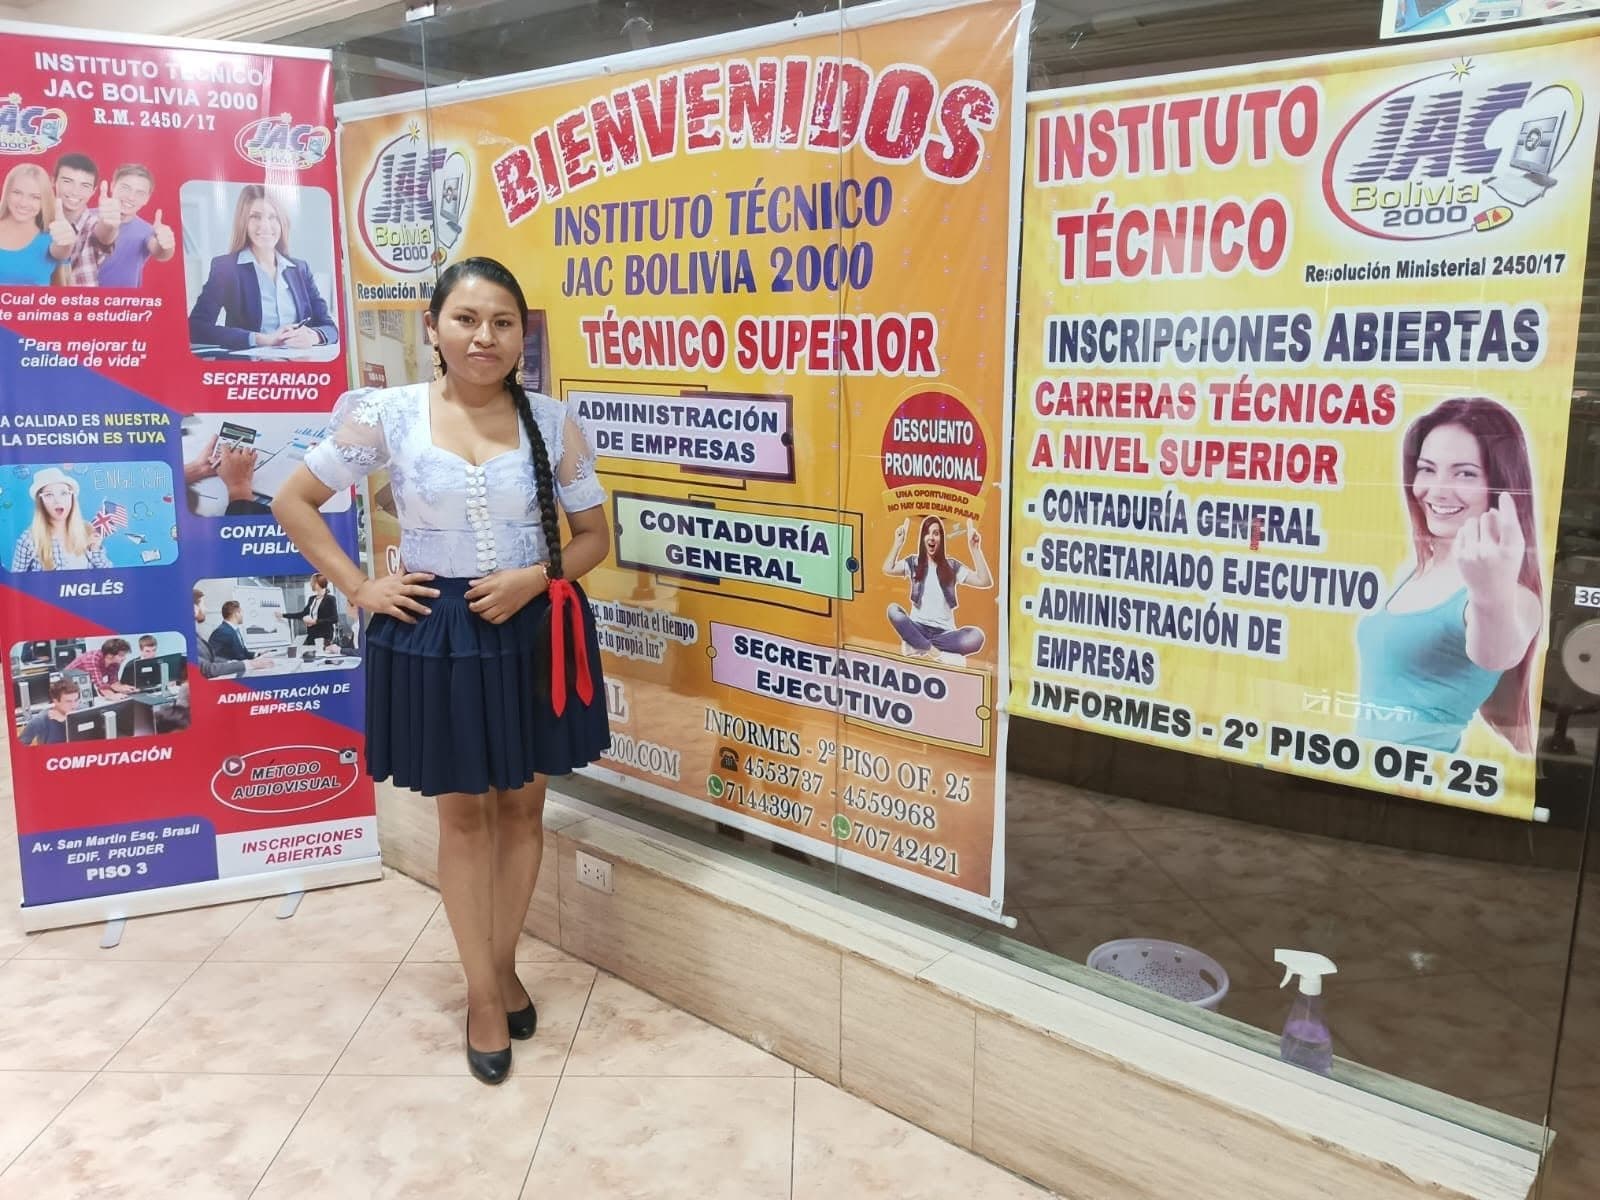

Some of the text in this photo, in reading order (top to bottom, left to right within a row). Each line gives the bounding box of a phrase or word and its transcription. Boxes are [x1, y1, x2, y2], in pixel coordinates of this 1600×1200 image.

[35, 51, 158, 79] INSTITUTO
[43, 78, 258, 110] JAC BOLIVIA 2000
[93, 107, 216, 131] R.M. 2450/17
[1038, 84, 1319, 183] INSTITUTO
[1345, 81, 1533, 183] JAC
[244, 121, 313, 152] JAC
[493, 58, 997, 223] BIENVENIDOS
[370, 147, 448, 224] JAC
[1350, 178, 1480, 213] Bolivia
[554, 175, 893, 247] INSTITUTO TÉCNICO
[1383, 205, 1468, 227] 2000
[374, 224, 432, 248] Bolivia
[1057, 196, 1288, 282] TÉCNICO
[392, 246, 429, 262] 2000
[1305, 253, 1566, 283] Resolución Ministerial 2450/17
[561, 241, 874, 298] JAC BOLIVIA 2000
[1, 293, 162, 307] Cual de estas carreras
[357, 281, 417, 299] Resolución
[17, 309, 69, 321] animas
[74, 312, 82, 321] a
[87, 310, 152, 322] estudiar?
[67, 339, 128, 355] mejorar
[131, 340, 146, 351] tu
[581, 310, 937, 374] TÉCNICO SUPERIOR
[1047, 307, 1540, 364] INSCRIPCIONES ABIERTAS
[21, 354, 78, 367] calidad
[83, 354, 102, 367] de
[202, 372, 331, 386] SECRETARIADO
[227, 387, 318, 400] EJECUTIVO
[1035, 374, 1396, 426] CARRERAS TÉCNICAS
[14, 414, 78, 428] CALIDAD
[82, 414, 100, 427] ES
[104, 413, 170, 426] NUESTRA
[578, 400, 778, 433] ADMINISTRACIÓN
[2, 430, 166, 446] LA DECISIÓN ES TUYA
[596, 430, 755, 464] DE EMPRESAS
[893, 418, 974, 446] DESCUENTO
[884, 452, 983, 482] PROMOCIONAL
[1032, 433, 1339, 485] A NIVEL SUPERIOR
[888, 501, 980, 521] NO HAY QUE DEJAR PASAR
[896, 490, 969, 505] UNA OPORTUNIDAD
[639, 509, 829, 556] CONTADURÍA
[1042, 488, 1321, 547] CONTADURÍA GENERAL
[666, 544, 802, 584] GENERAL
[1041, 538, 1379, 611] SECRETARIADO EJECUTIVO
[59, 579, 124, 597] INGLÉS
[603, 605, 614, 621] no
[615, 605, 649, 629] importa
[651, 613, 660, 632] el
[662, 616, 695, 641] tiempo
[1038, 587, 1282, 655] ADMINISTRACIÓN DE
[605, 630, 614, 648] tu
[616, 633, 643, 656] propia
[734, 635, 946, 700] SECRETARIADO
[1037, 635, 1155, 686] EMPRESAS
[217, 683, 350, 705] ADMINISTRACIÓN DE
[250, 699, 321, 716] EMPRESAS
[757, 670, 913, 725] EJECUTIVO
[1032, 680, 1192, 739] INFORMES
[1270, 726, 1360, 770] PISO
[1374, 745, 1433, 786] OF.
[1447, 759, 1498, 798] 25
[46, 746, 173, 771] COMPUTACIÓN
[704, 707, 800, 758] INFORMES
[842, 744, 890, 783] PISO
[897, 762, 937, 796] OF.
[945, 772, 971, 803] 25
[232, 776, 341, 800] AUDIOVISUAL
[744, 756, 823, 795] 4553737
[843, 784, 937, 830] 4559968
[32, 842, 53, 854] Av.
[57, 838, 83, 850] San
[130, 830, 158, 843] Esq.
[162, 824, 200, 838] Brasil
[241, 827, 364, 854] INSCRIPCIONES
[725, 782, 814, 827] 71443907
[853, 822, 960, 876] 70742421
[67, 843, 164, 864] EDIF. PRUDER
[265, 844, 342, 865] ABIERTAS
[86, 862, 148, 881] PISO 3
